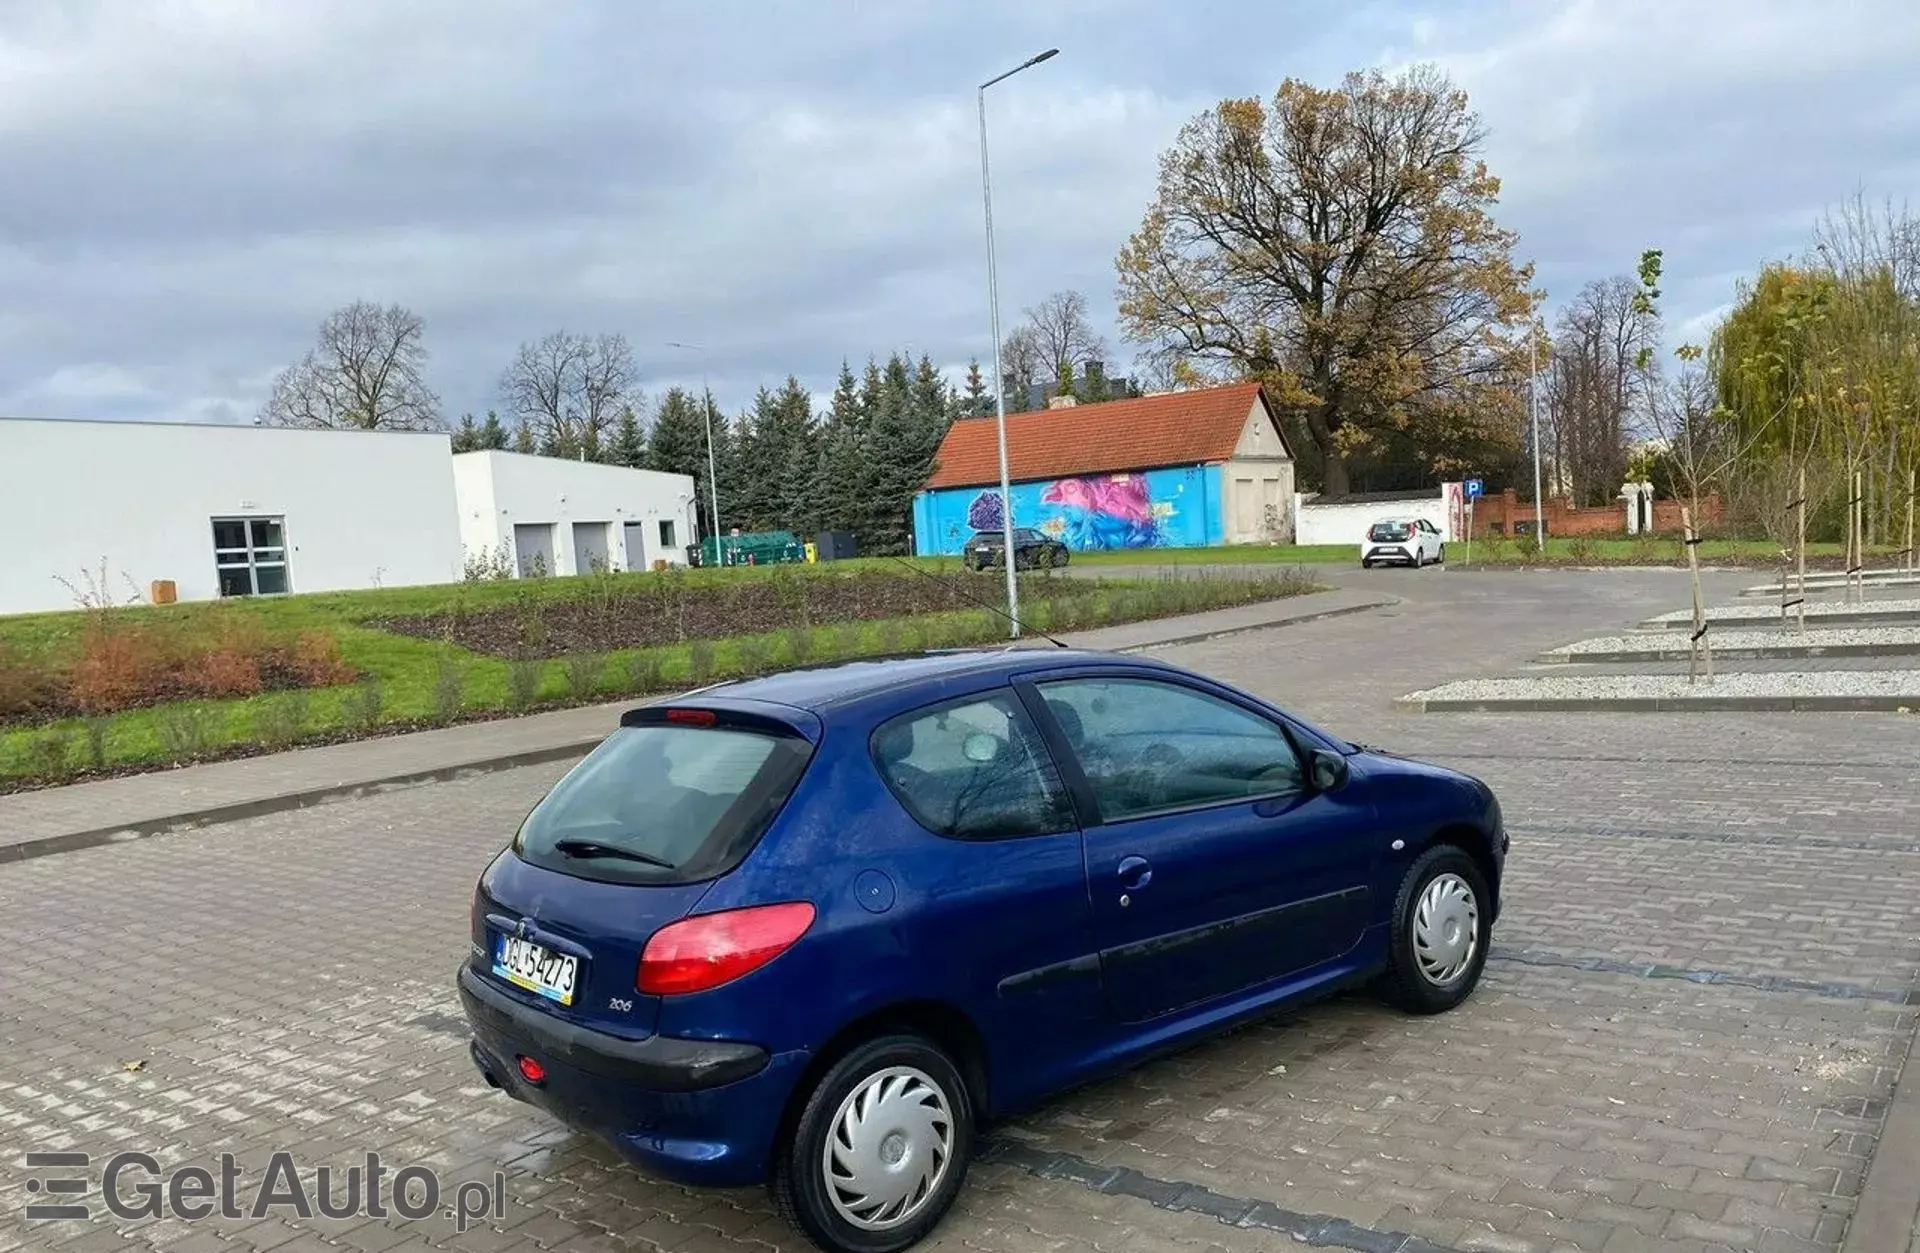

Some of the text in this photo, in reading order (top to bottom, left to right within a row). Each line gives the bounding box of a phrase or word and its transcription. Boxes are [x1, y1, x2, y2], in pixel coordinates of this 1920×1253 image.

[1468, 482, 1479, 495] P
[527, 945, 574, 991] 54273
[609, 998, 633, 1012] 206
